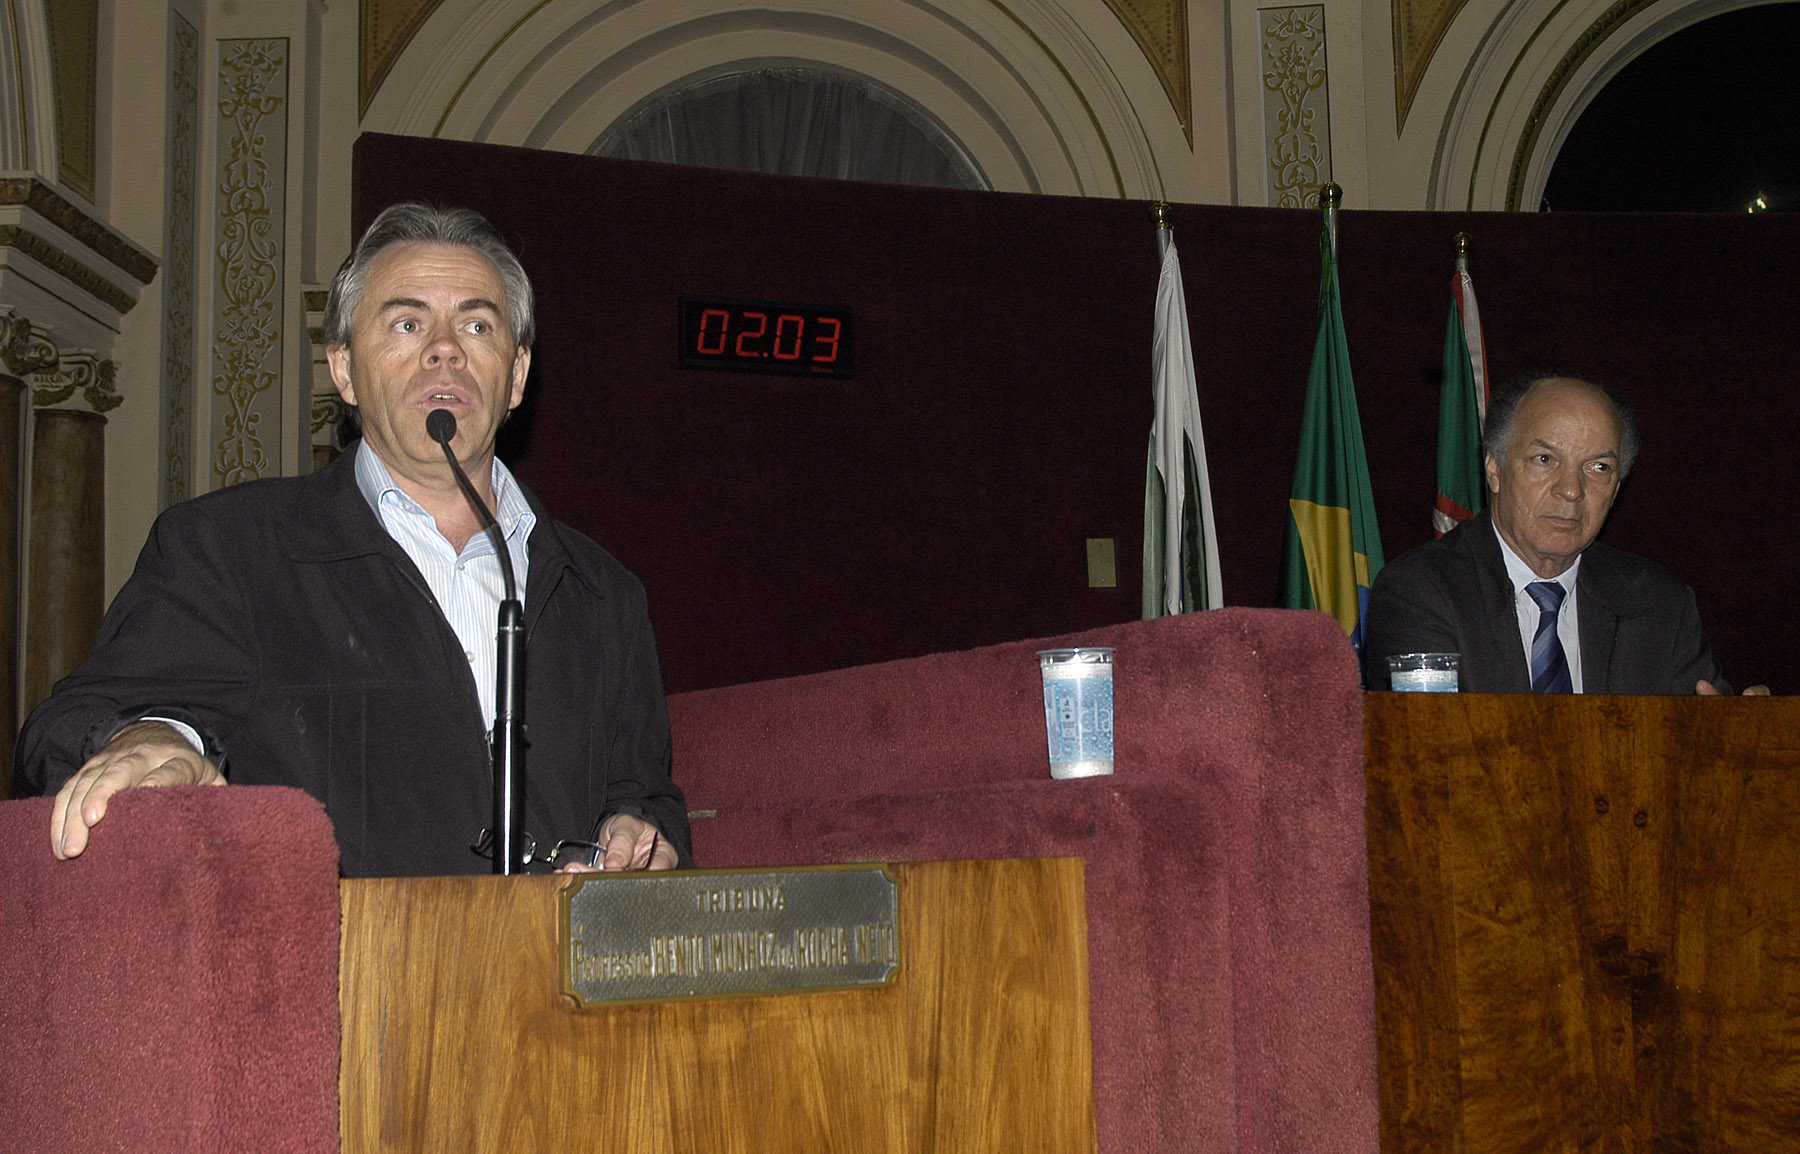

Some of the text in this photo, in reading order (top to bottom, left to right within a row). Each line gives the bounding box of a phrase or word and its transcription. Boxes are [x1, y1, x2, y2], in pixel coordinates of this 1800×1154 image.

[697, 309, 841, 362] 02.03
[696, 888, 787, 912] TRIBUNA
[653, 934, 704, 977] BENTO
[710, 930, 776, 973] MUNHOZ
[796, 927, 849, 968] ROCHA
[856, 925, 894, 963] NETO
